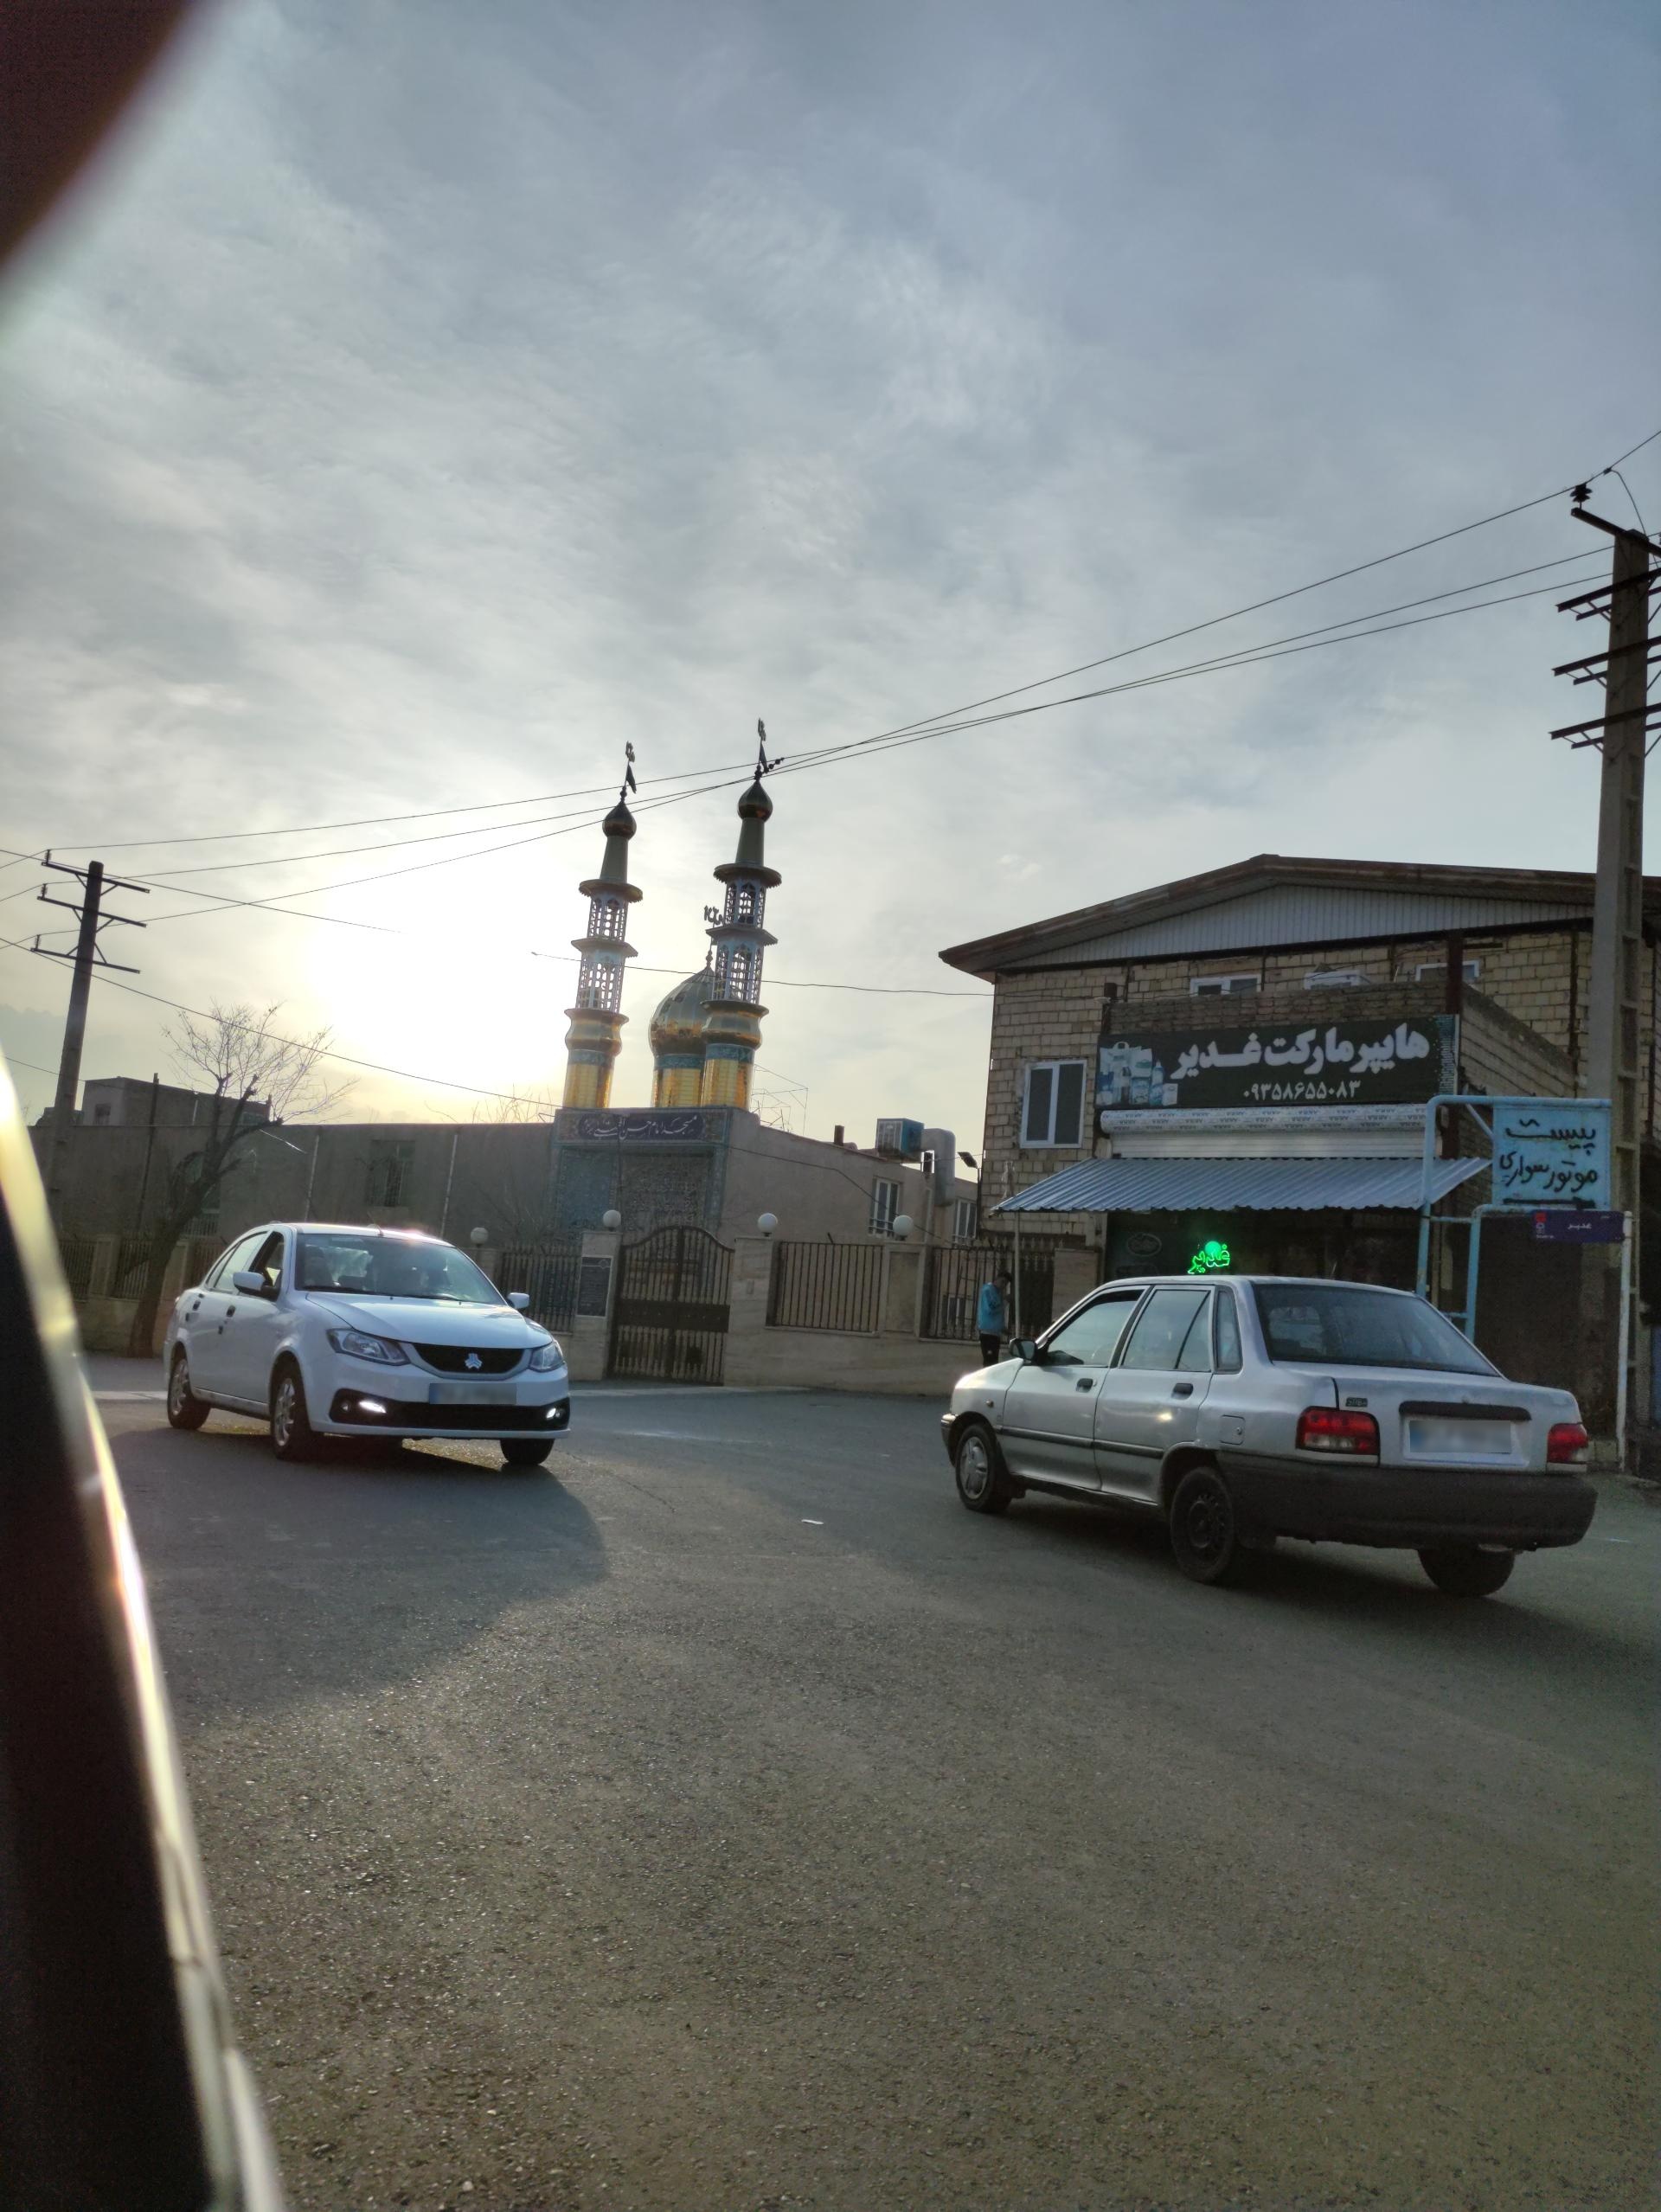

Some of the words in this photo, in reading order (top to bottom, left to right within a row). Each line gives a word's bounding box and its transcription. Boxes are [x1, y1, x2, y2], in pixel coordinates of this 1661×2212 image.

[1170, 1032, 1262, 1080] غدیر
[1264, 1026, 1354, 1074] مارکت
[1349, 1022, 1430, 1074] هایپر
[1243, 1080, 1362, 1101] ۰۹۳۵۸۶۵۵۰۸۳
[1504, 1119, 1597, 1156] پیست
[1499, 1151, 1549, 1187] سواری
[1542, 1160, 1598, 1193] موتور
[1187, 1244, 1230, 1274] غدیر
